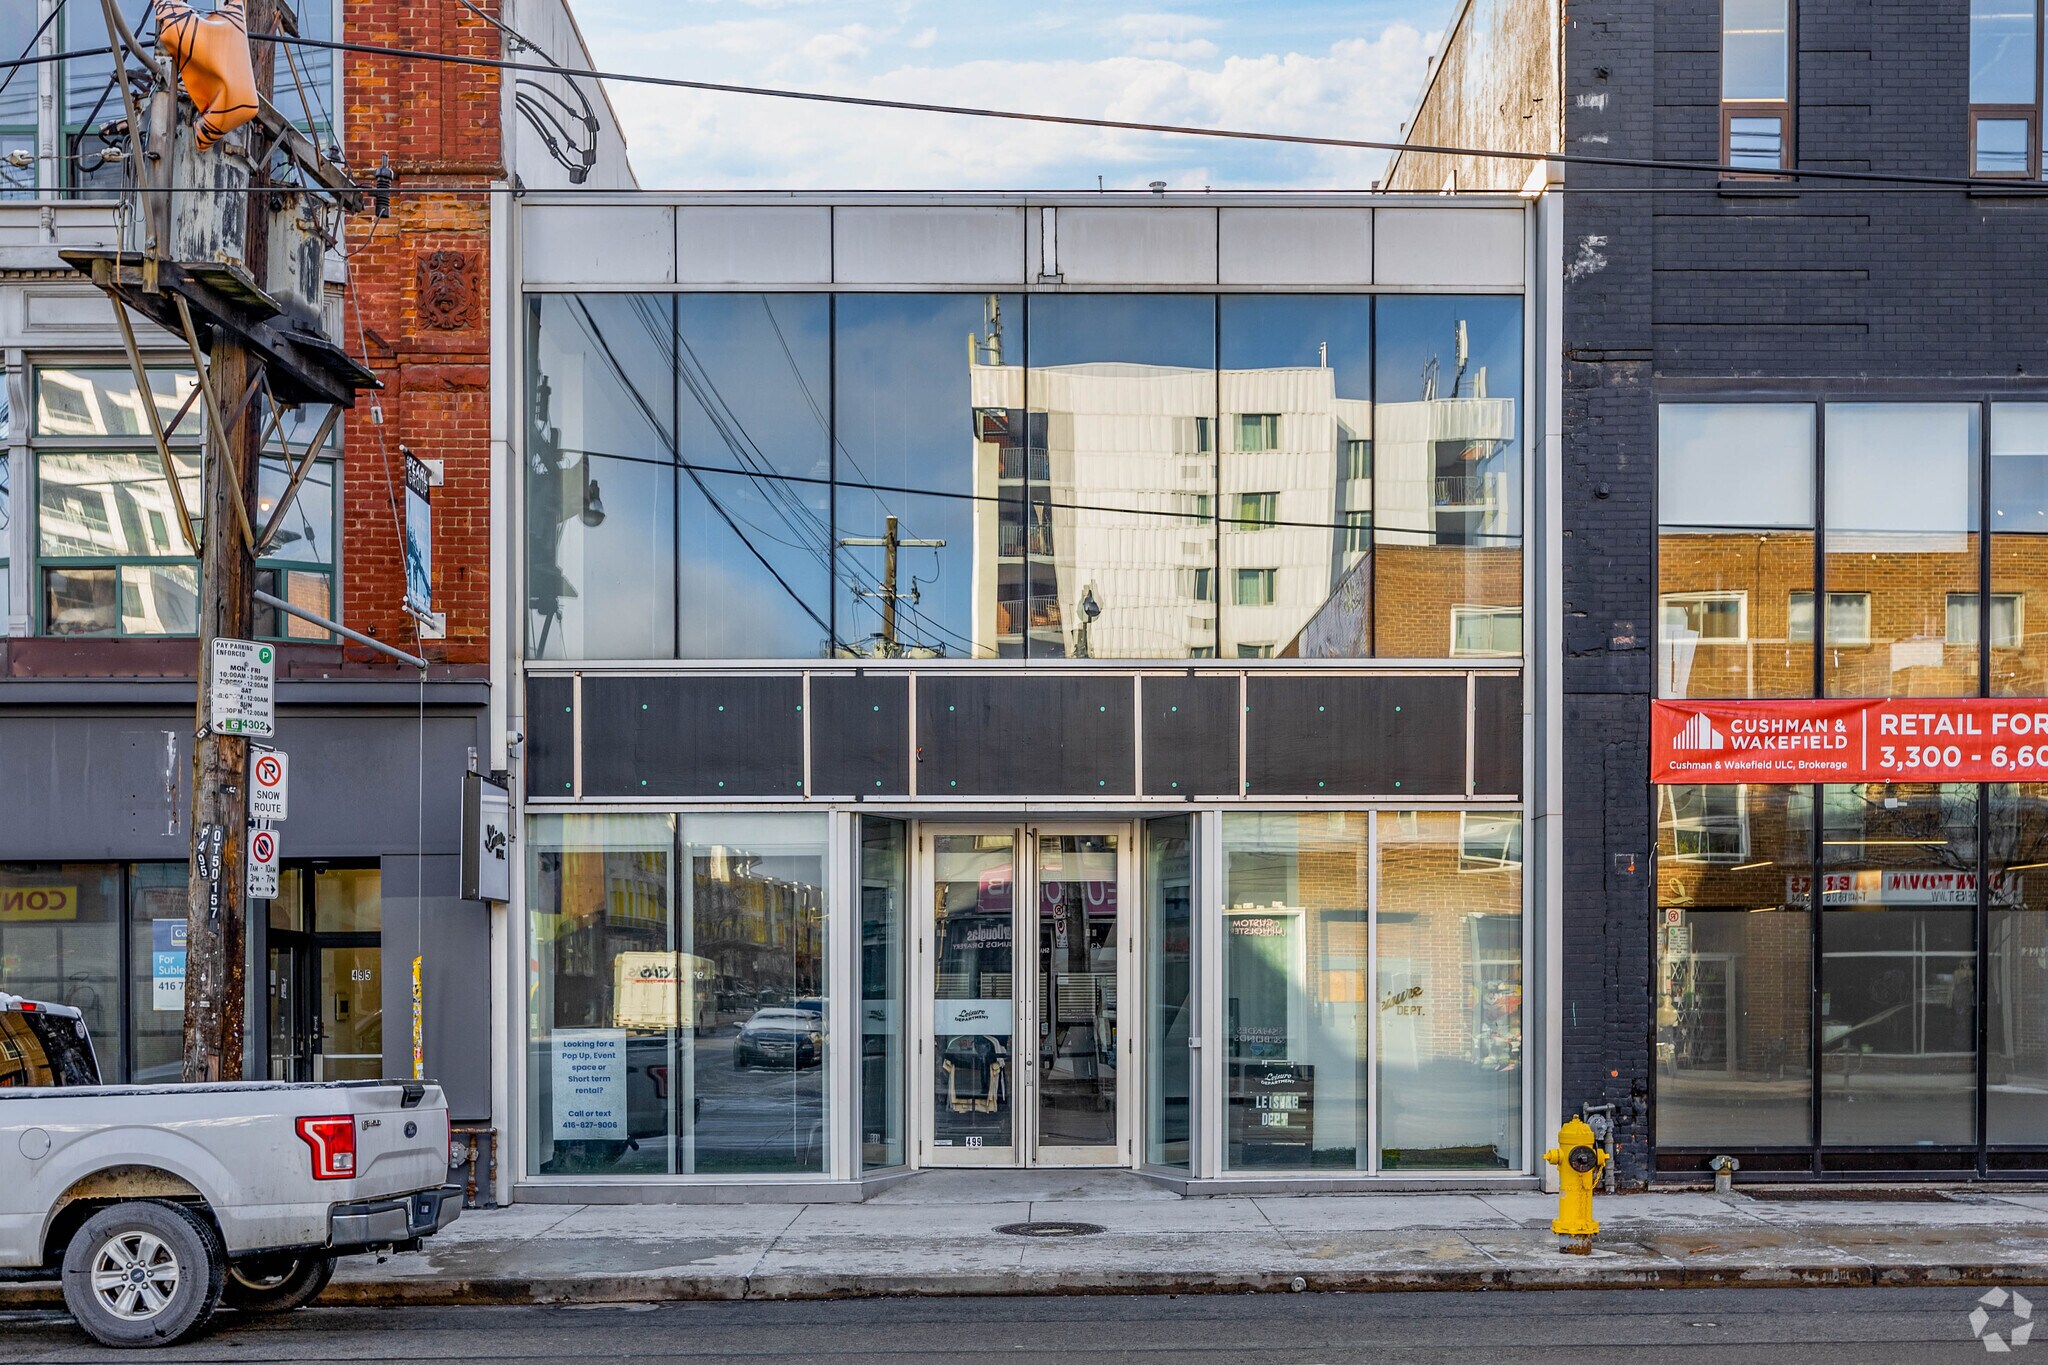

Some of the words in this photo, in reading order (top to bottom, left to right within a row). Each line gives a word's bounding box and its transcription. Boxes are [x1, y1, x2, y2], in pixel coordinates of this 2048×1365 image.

[230, 643, 253, 651] PARKING
[242, 719, 265, 730] 4302
[1730, 719, 1831, 733] CUSHMAN
[1835, 719, 1847, 733] &
[1881, 714, 1981, 735] RETAIL
[1992, 714, 2048, 735] FOR
[1730, 735, 1848, 750] WAKEFIELD
[1880, 746, 1962, 771] 3,300
[1669, 761, 1712, 770] Cushman
[1715, 761, 1722, 770] &
[1724, 760, 1772, 770] Wakefield
[1775, 761, 1796, 771] ULC,
[1798, 760, 1847, 772] Brokerage
[256, 790, 280, 800] SNOW
[254, 802, 282, 813] ROUTE
[250, 863, 258, 872] 7AM
[265, 864, 276, 873] 10AM
[250, 873, 259, 882] 3PM
[266, 874, 276, 883] 7PM
[159, 955, 174, 964] For
[352, 970, 371, 980] 495
[158, 982, 176, 990] 416
[959, 1009, 986, 1018] Leisure
[1397, 1006, 1425, 1015] DEPT.
[564, 1041, 594, 1049] Looking
[572, 1064, 596, 1072] space
[1256, 1096, 1298, 1109] LEISURE
[966, 1137, 982, 1146] 499
